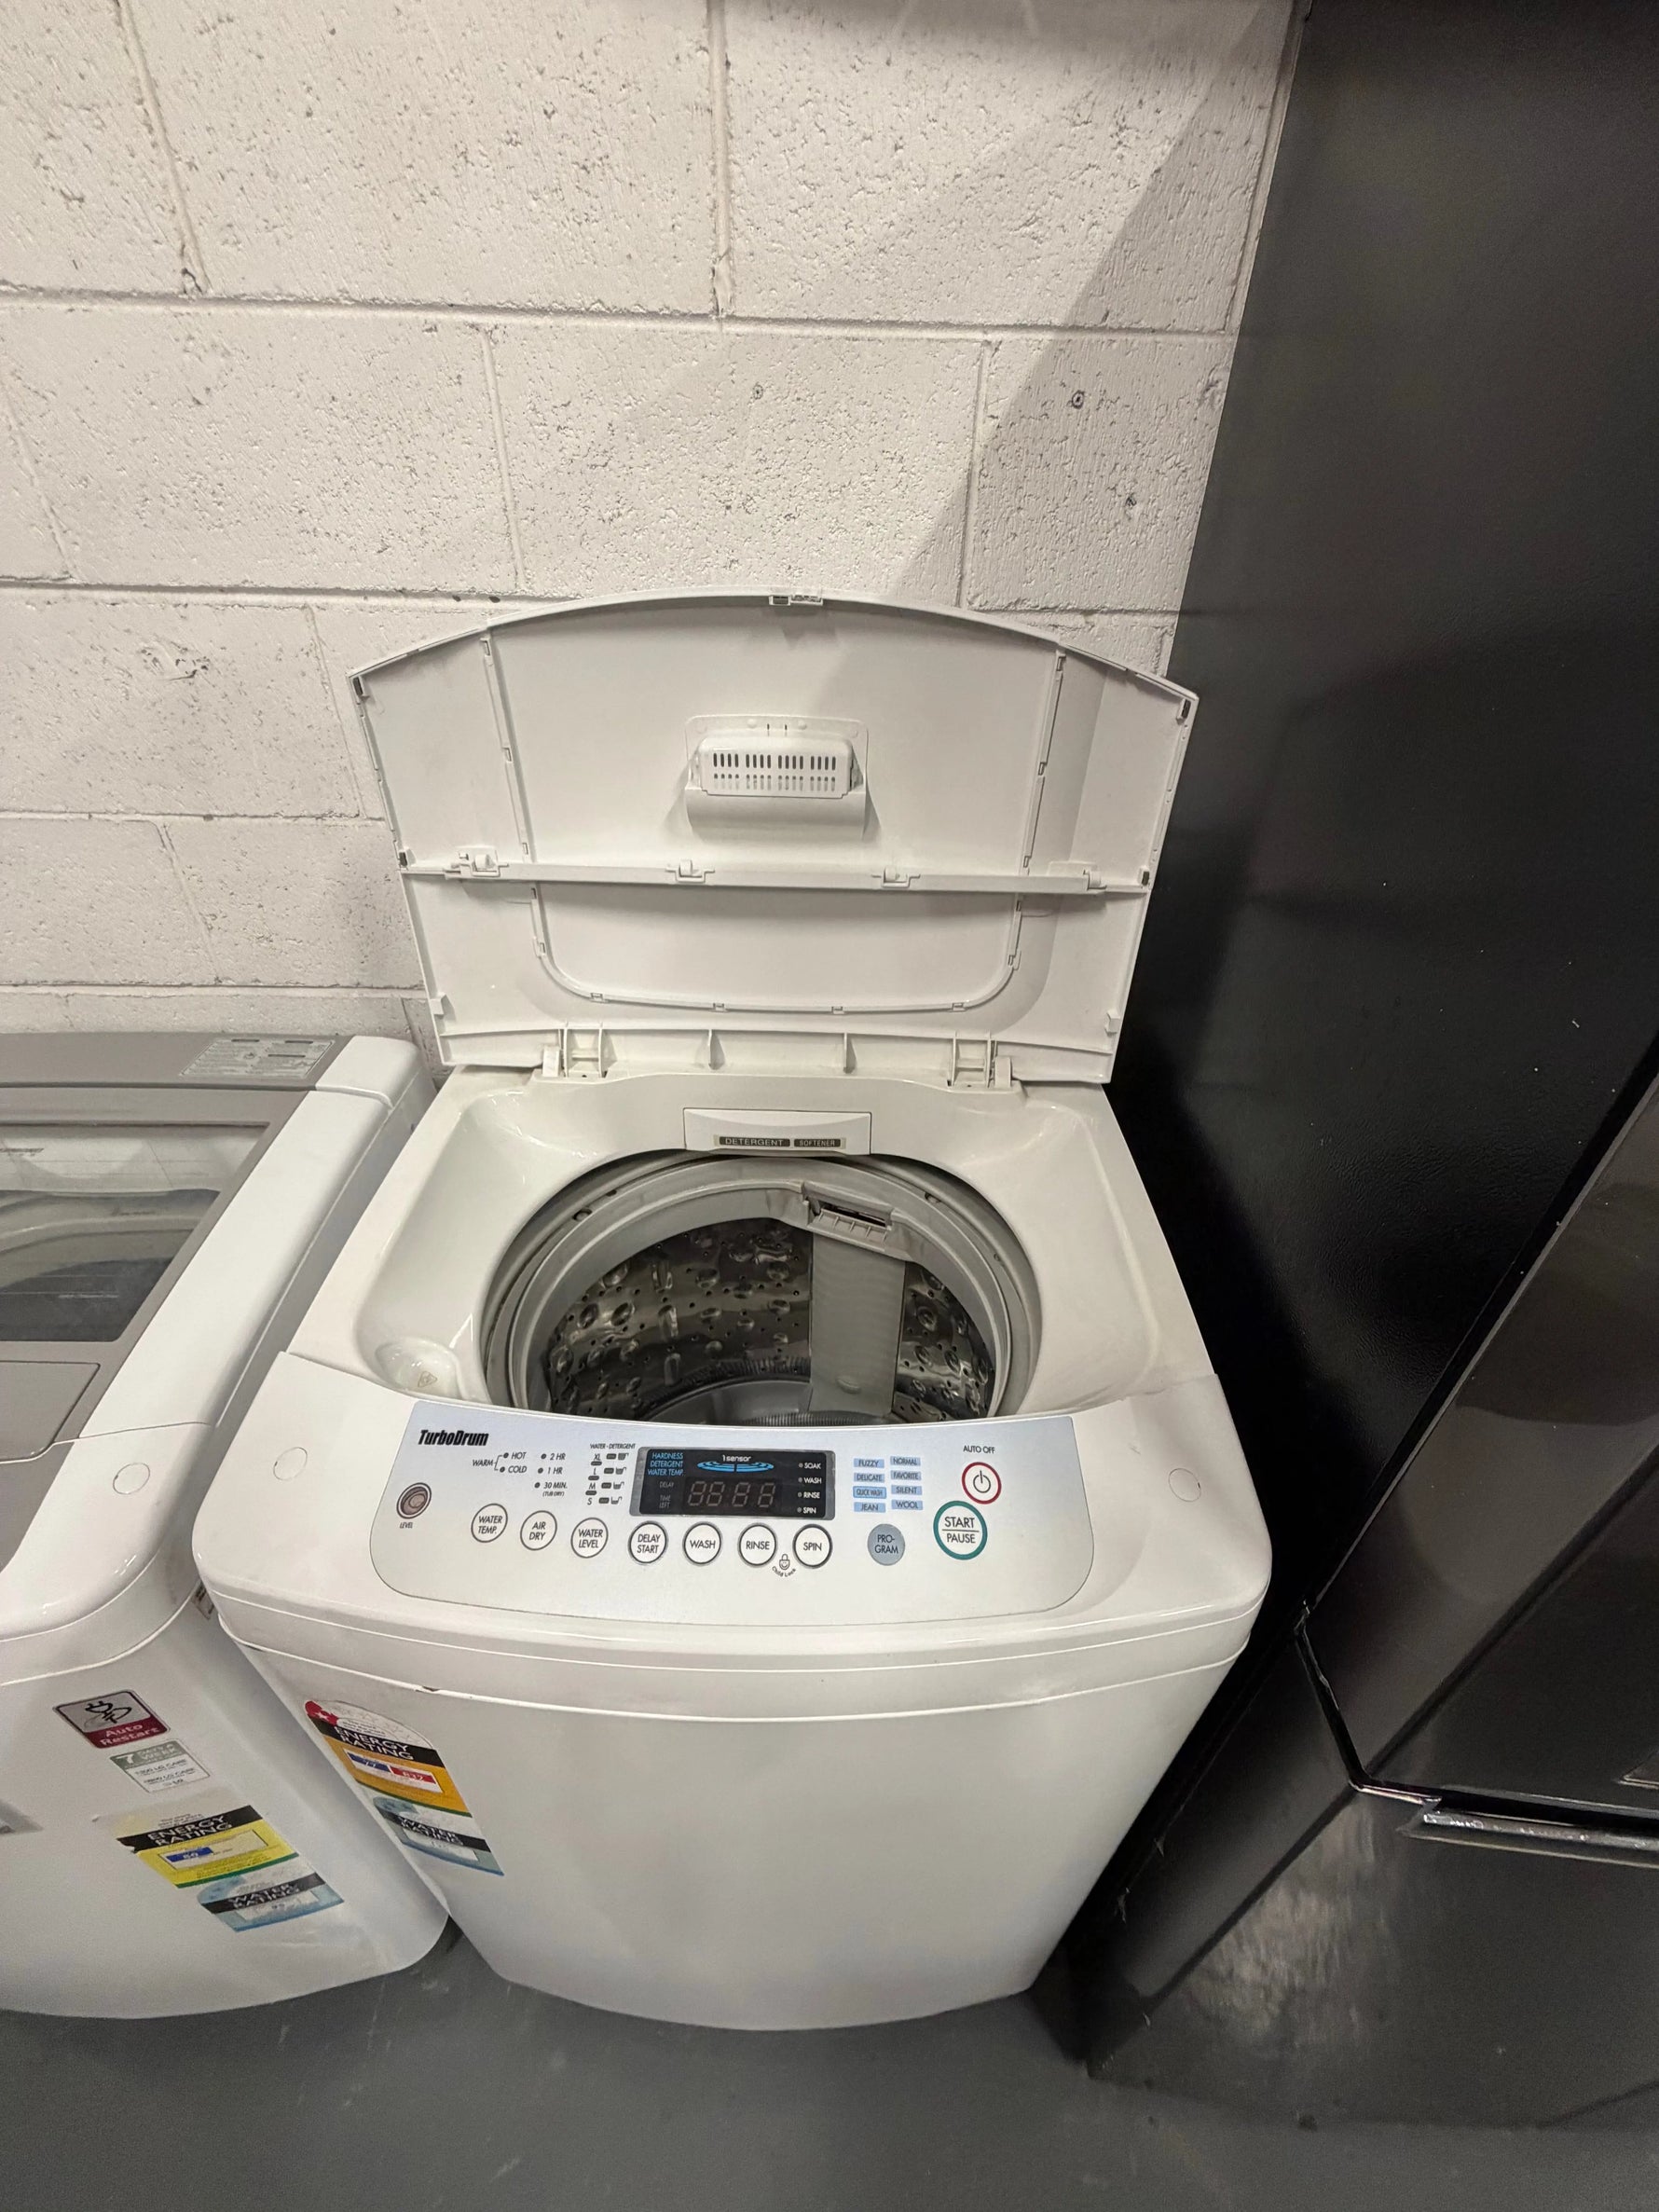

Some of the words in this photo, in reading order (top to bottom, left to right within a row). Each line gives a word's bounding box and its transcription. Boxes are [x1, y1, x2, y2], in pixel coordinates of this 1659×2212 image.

[725, 1137, 783, 1147] DETERGENT
[799, 1139, 835, 1147] SOFTENER
[418, 1429, 489, 1446] TurboDrum
[511, 1451, 527, 1460] HOT
[555, 1452, 566, 1461] HR
[473, 1459, 494, 1467] WARM
[650, 1460, 683, 1468] DETERGENT
[804, 1462, 822, 1470] SOAK
[508, 1465, 528, 1474] COLD
[896, 1486, 917, 1494] SILENT
[896, 1501, 918, 1509] WOOL
[478, 1515, 502, 1524] WATER
[944, 1517, 975, 1528] START
[531, 1521, 546, 1531] AIR
[528, 1532, 546, 1541] DRY
[578, 1529, 603, 1538] WATER
[638, 1533, 661, 1543] DELAY
[877, 1534, 895, 1544] PRO-
[946, 1533, 976, 1544] PAUSE
[578, 1539, 599, 1548] LEVEL
[690, 1540, 716, 1549] WASH
[746, 1541, 770, 1550] RINSE
[802, 1542, 822, 1551] SPIN
[637, 1544, 660, 1554] START
[874, 1545, 898, 1554] GRAM
[105, 1724, 144, 1738] Auto
[100, 1727, 160, 1746] Restart
[335, 1726, 408, 1752] ENERGY
[341, 1735, 414, 1760] RATING
[147, 1815, 225, 1841] ENERGY
[155, 1822, 232, 1846] RATING
